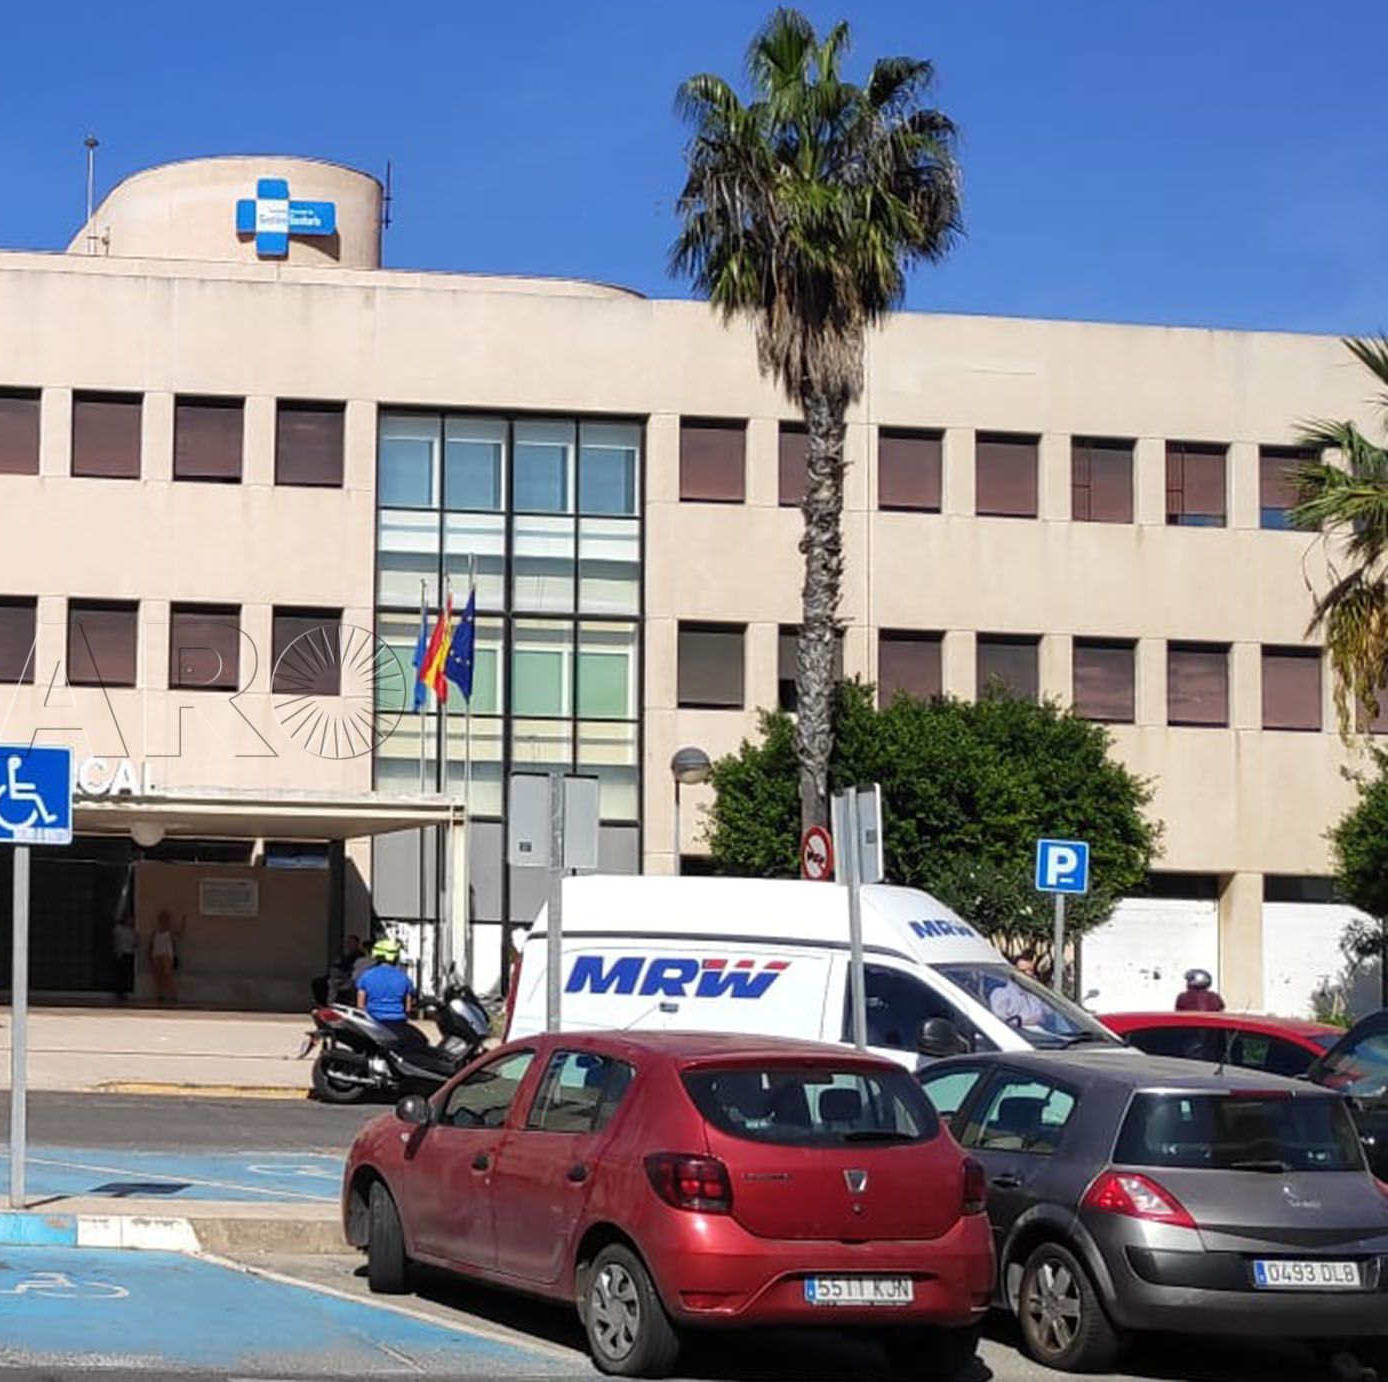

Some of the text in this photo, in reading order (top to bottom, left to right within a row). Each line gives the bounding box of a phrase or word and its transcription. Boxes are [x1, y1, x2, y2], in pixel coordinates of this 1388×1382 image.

[1047, 846, 1078, 885] P
[565, 955, 792, 999] MRW
[816, 1276, 865, 1298] 5511
[1267, 1263, 1355, 1283] 0493 DLB
